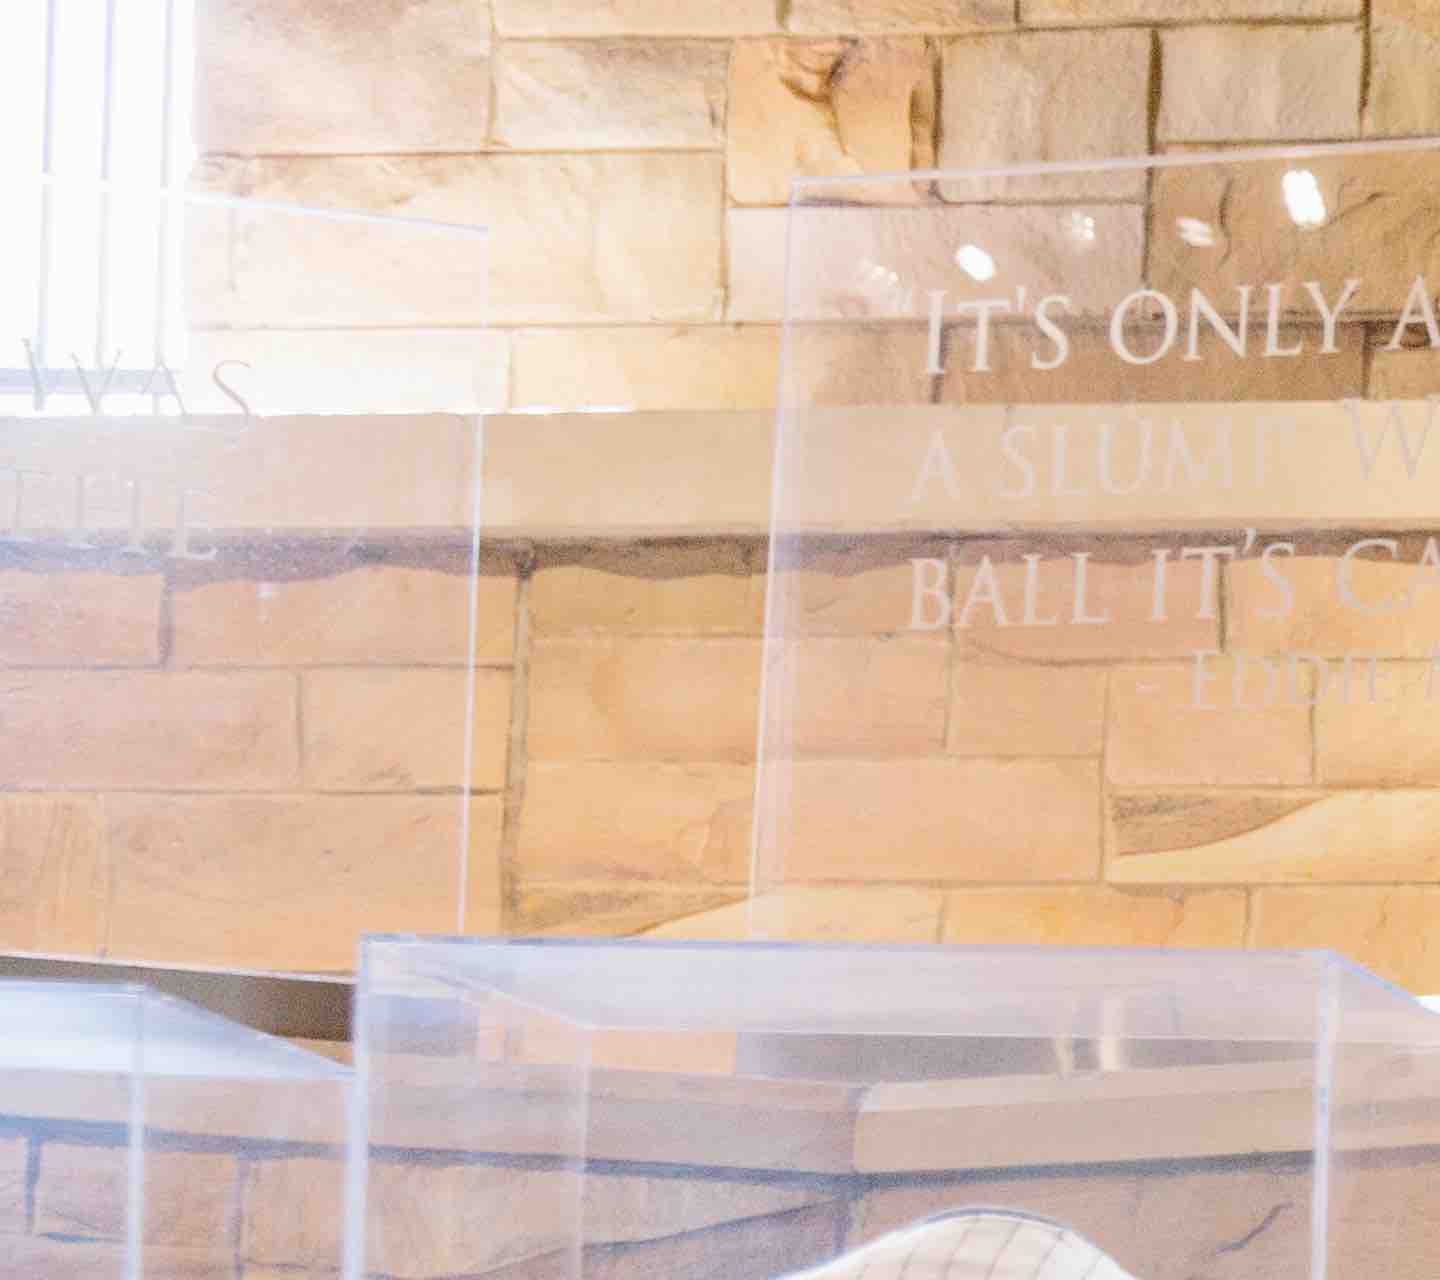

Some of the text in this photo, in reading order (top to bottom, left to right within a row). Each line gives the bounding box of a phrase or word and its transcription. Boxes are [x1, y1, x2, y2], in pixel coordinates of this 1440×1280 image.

[1109, 276, 1363, 366] ONLY
[904, 426, 963, 504] A
[907, 553, 1113, 632] BALL
[1148, 526, 1297, 624] IT'S
